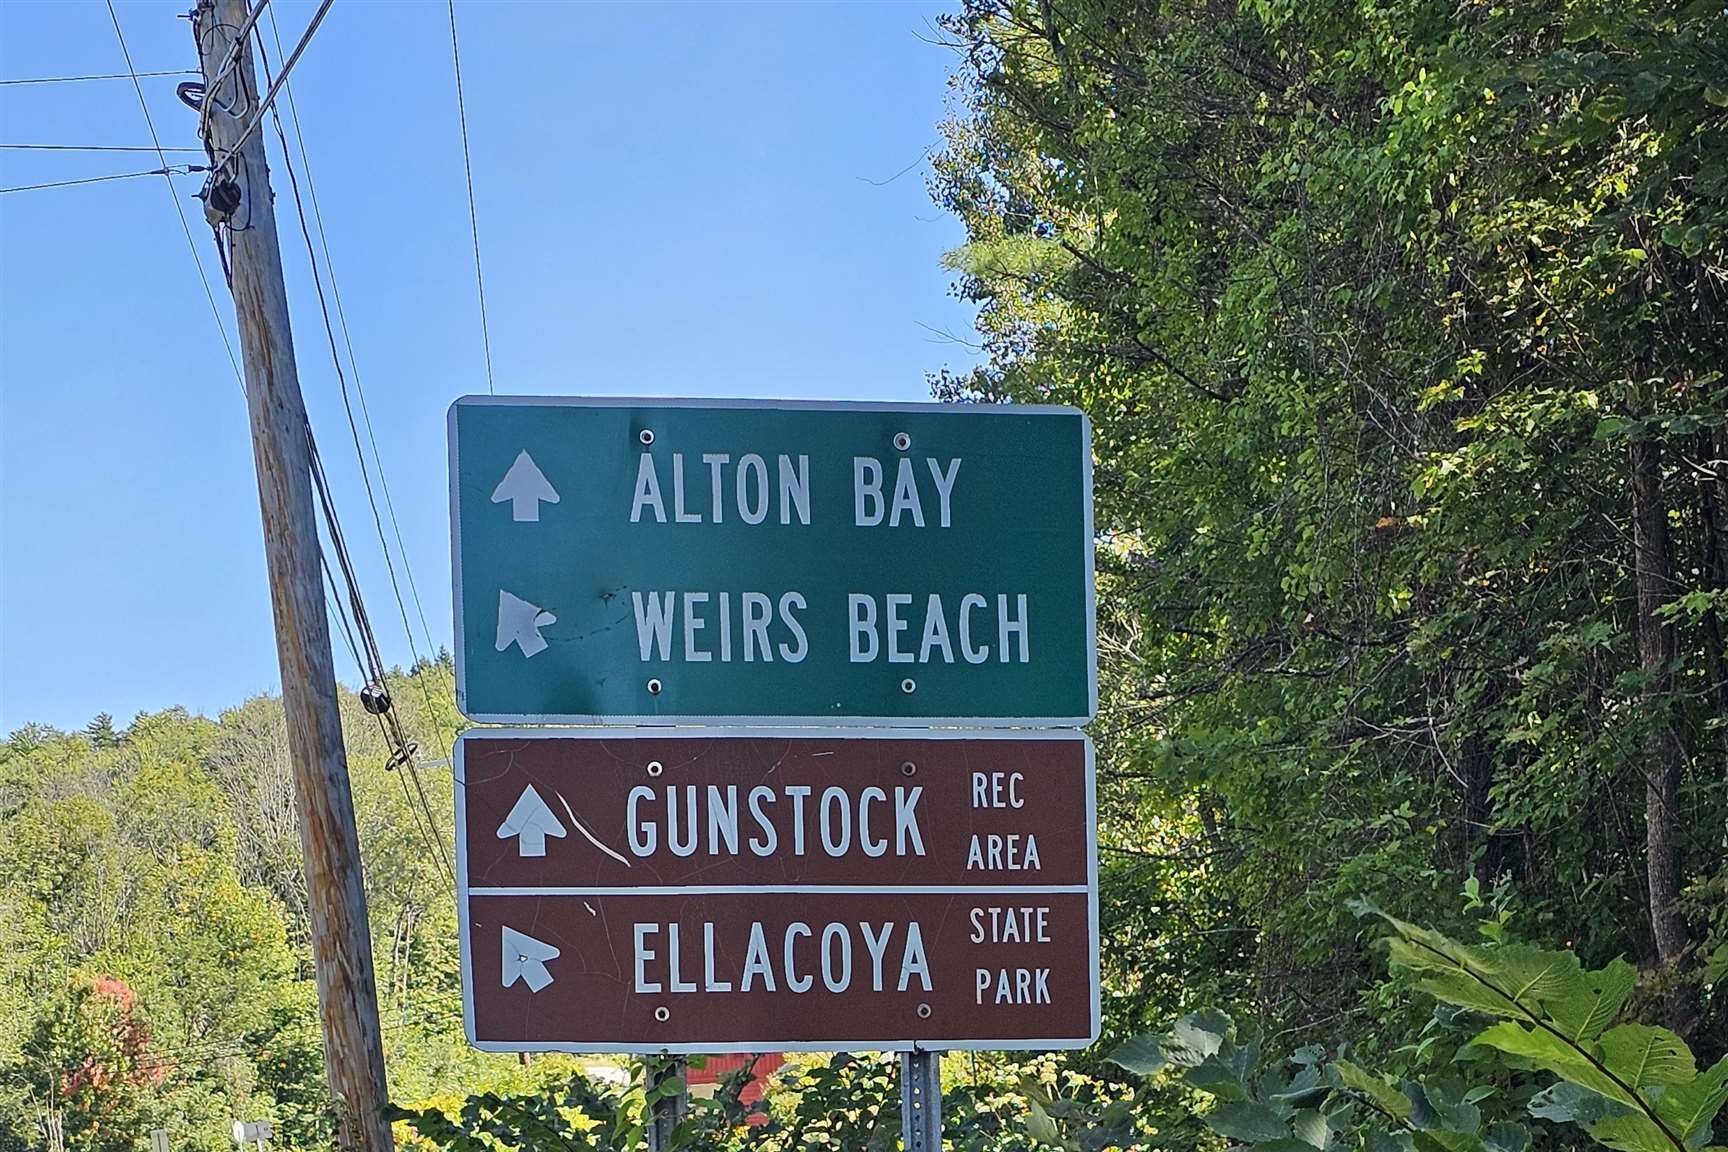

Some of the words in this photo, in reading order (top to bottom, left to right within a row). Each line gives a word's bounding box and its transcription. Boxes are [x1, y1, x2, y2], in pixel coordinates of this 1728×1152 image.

[630, 453, 810, 525] ALTON
[854, 457, 962, 527] BAY
[631, 591, 808, 663] WEIRS
[848, 593, 1030, 663] BEACH
[972, 771, 1025, 808] REC
[626, 785, 926, 858] GUNSTOCK
[967, 834, 1041, 870] AREA
[970, 907, 1051, 943] STATE
[634, 921, 933, 994] ELLACOYA
[976, 969, 1051, 1005] PARK
